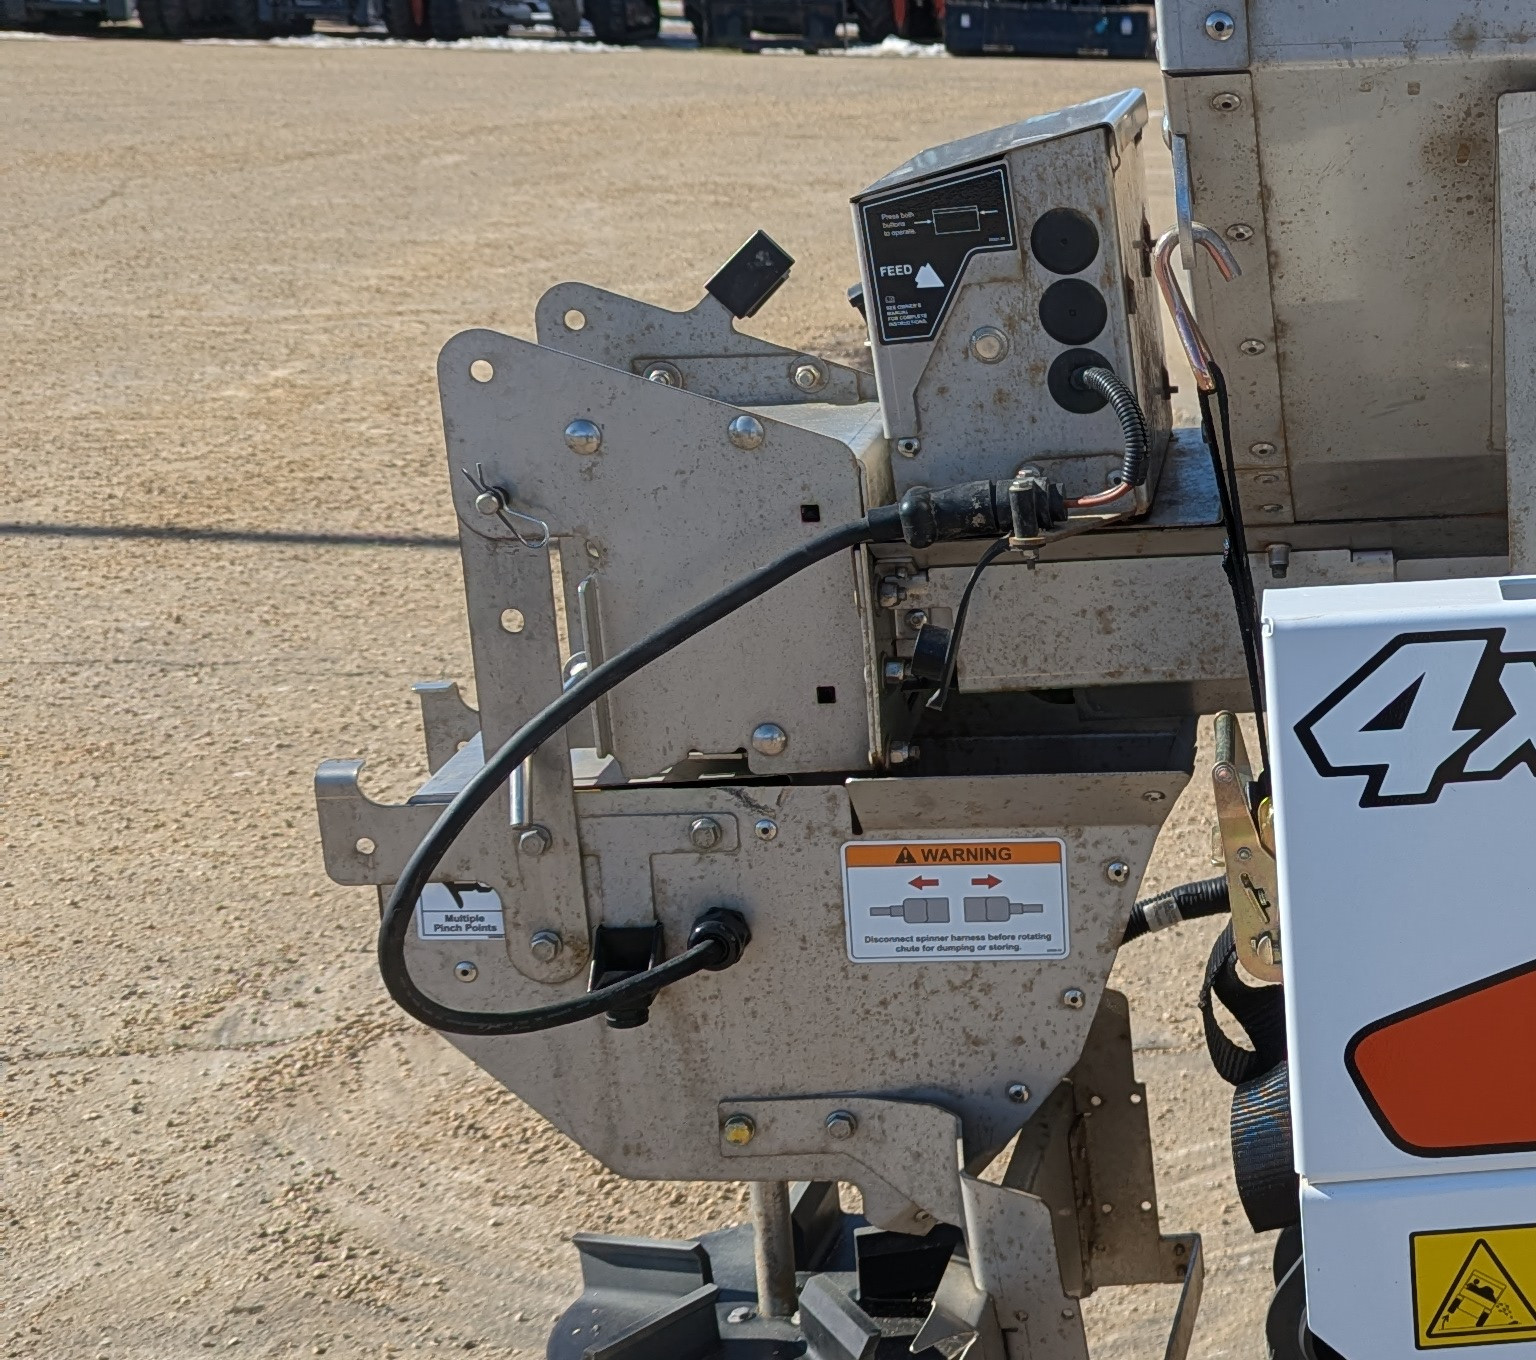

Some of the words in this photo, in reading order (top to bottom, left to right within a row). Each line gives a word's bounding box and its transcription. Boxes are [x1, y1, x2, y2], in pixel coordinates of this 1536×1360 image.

[880, 264, 913, 277] FEED
[921, 847, 1012, 862] WARNING
[444, 914, 485, 924] Multiple
[433, 923, 462, 932] Pinch
[465, 923, 497, 932] Points
[864, 935, 914, 944] Disconnect
[916, 935, 949, 944] spinner
[950, 934, 986, 942] harness
[988, 933, 1016, 941] before
[1018, 933, 1052, 942] rotating
[895, 945, 920, 953] chute
[922, 944, 935, 952] for
[936, 944, 975, 953] dumping
[989, 943, 1022, 952] storing.
